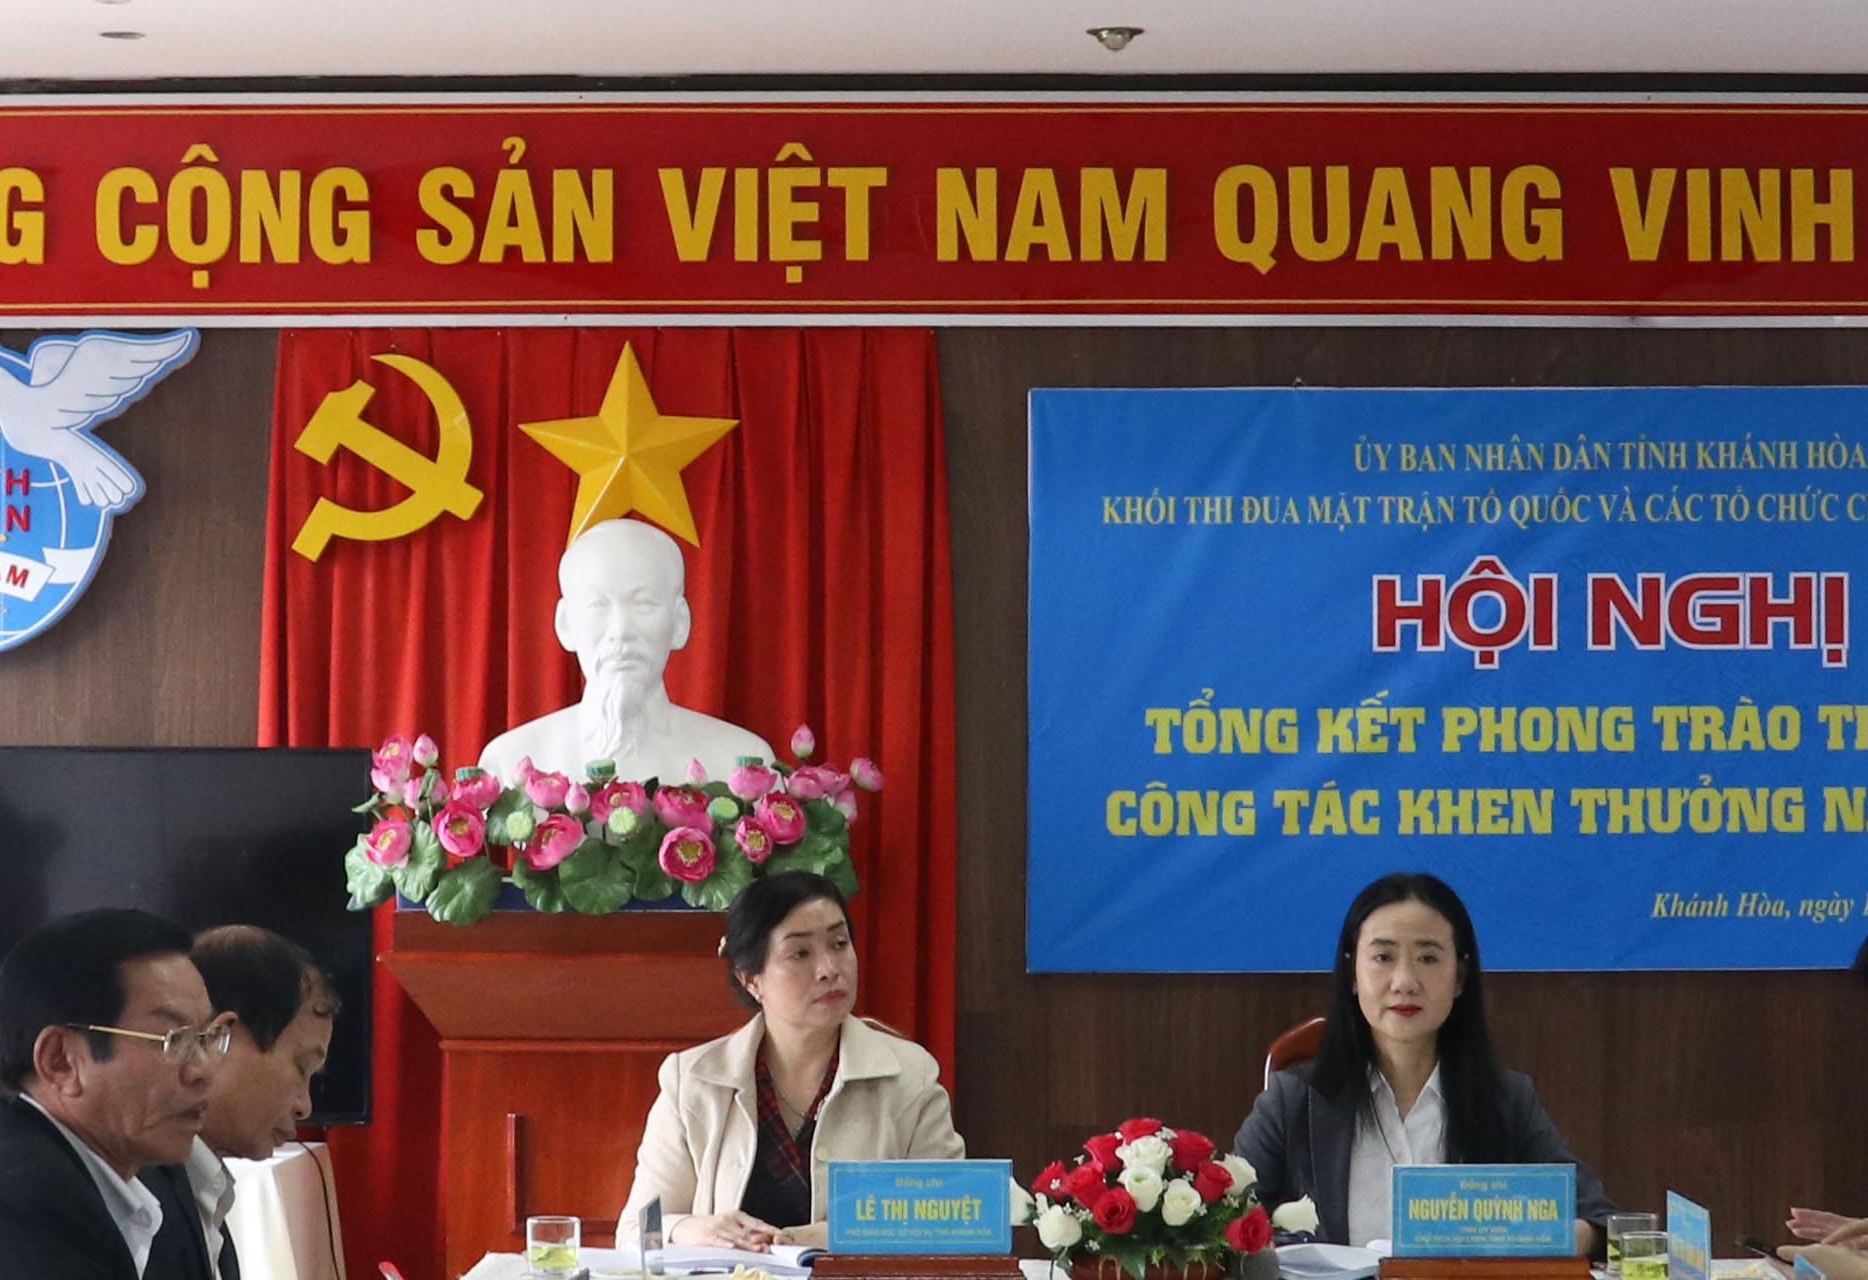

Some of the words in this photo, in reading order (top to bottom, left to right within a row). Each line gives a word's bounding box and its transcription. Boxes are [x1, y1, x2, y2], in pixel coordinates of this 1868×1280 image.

[93, 142, 372, 290] CỘNG
[413, 135, 616, 265] SẢN
[657, 141, 889, 284] VIỆT
[935, 166, 1168, 263] NAM
[1213, 163, 1564, 275] QUANG
[1609, 167, 1855, 263] VINH
[1353, 434, 1393, 472] ỦY
[1399, 442, 1457, 472] BAN
[1464, 433, 1545, 472] NHÂN
[1553, 433, 1612, 471] DÂN
[1618, 432, 1688, 471] TỈNH
[1696, 432, 1799, 471] KHÁNH
[1806, 432, 1868, 470] HÒA
[1102, 487, 1176, 525] KHỐI
[1184, 495, 1234, 525] THI
[1241, 495, 1301, 525] ĐUA
[1307, 490, 1372, 531] MẶT
[1378, 494, 1456, 531] TRẬN
[1462, 488, 1503, 524] TỔ
[1509, 486, 1592, 529] QUỐC
[1599, 486, 1638, 523] VÀ
[1645, 485, 1705, 523] CÁC
[1710, 486, 1751, 523] TỔ
[1757, 485, 1840, 522] CHỨC
[1372, 554, 1559, 670] HỘI
[1587, 571, 1850, 669] NGHỊ
[1145, 688, 1301, 756] TỔNG
[1317, 689, 1427, 754] KẾT
[1441, 706, 1637, 754] PHONG
[1652, 696, 1803, 753] TRÀO
[1105, 780, 1257, 837] CÔNG
[1273, 779, 1381, 836] TÁC
[1398, 787, 1557, 835] KHEN
[1570, 774, 1807, 836] THƯỞNG
[1651, 891, 1730, 919] Khánh
[1736, 891, 1792, 919] Hòa,
[1798, 896, 1856, 922] ngày
[855, 1194, 877, 1221] LÊ
[881, 1199, 909, 1224] THỊ
[913, 1194, 982, 1224] NGUYỆT
[1527, 1198, 1559, 1221] NGA
